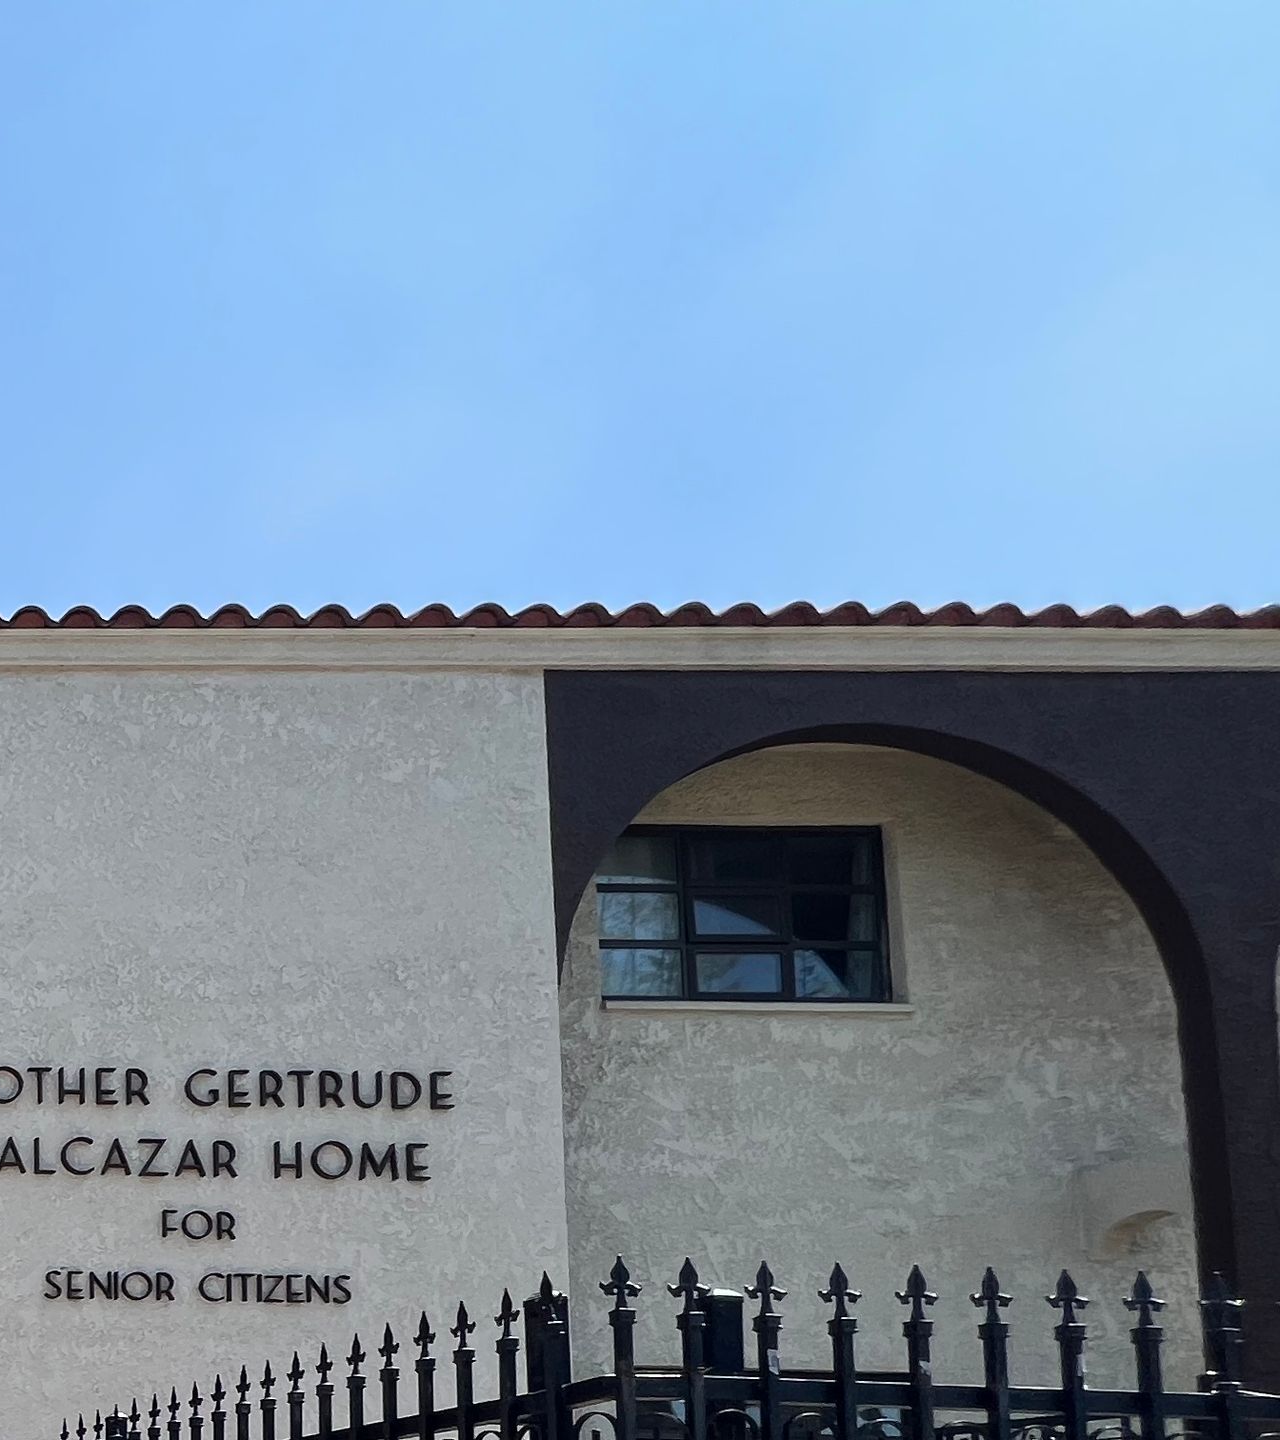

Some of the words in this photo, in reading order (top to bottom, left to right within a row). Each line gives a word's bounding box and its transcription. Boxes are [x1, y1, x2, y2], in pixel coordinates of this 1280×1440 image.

[184, 1068, 456, 1111] GERTRUDE
[273, 1140, 432, 1182] HOME
[161, 1209, 237, 1241] FOR
[43, 1270, 175, 1301] SENIOR
[198, 1273, 352, 1305] CITIZENS
